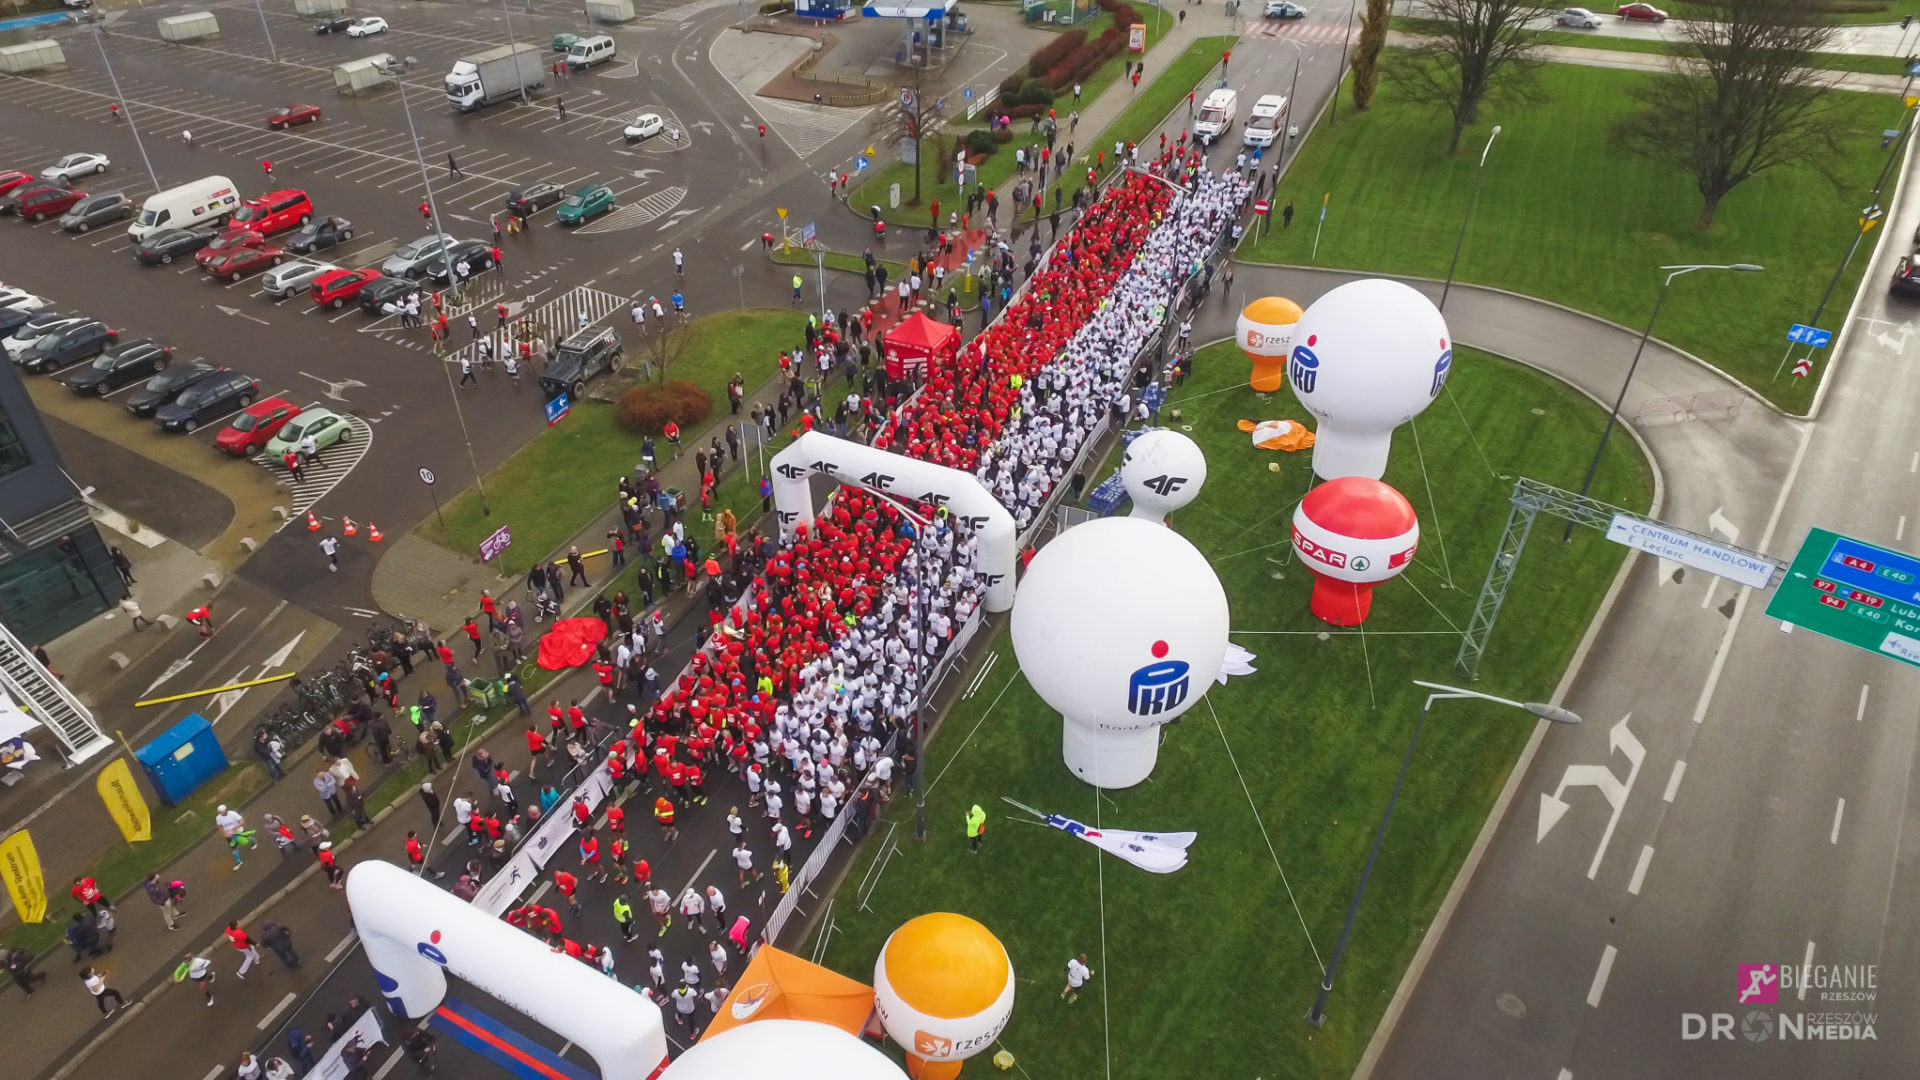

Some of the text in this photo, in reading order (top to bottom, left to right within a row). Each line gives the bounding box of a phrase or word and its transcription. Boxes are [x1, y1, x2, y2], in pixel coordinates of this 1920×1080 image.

[1265, 335, 1292, 345] rzesz
[1290, 345, 1320, 394] PKO
[420, 470, 433, 482] 10
[859, 471, 896, 490] 4F
[1142, 474, 1189, 497] 4F
[1294, 532, 1345, 566] SPAR
[1631, 524, 1768, 574] CENTRUM HANDLOWE
[1642, 540, 1685, 560] Leclerc
[1849, 559, 1858, 567] A
[1891, 572, 1907, 581] 40
[1818, 581, 1831, 590] 97
[1826, 597, 1839, 607] 94
[1865, 596, 1878, 606] 19
[1866, 610, 1881, 620] 40
[1127, 660, 1190, 716] PKO
